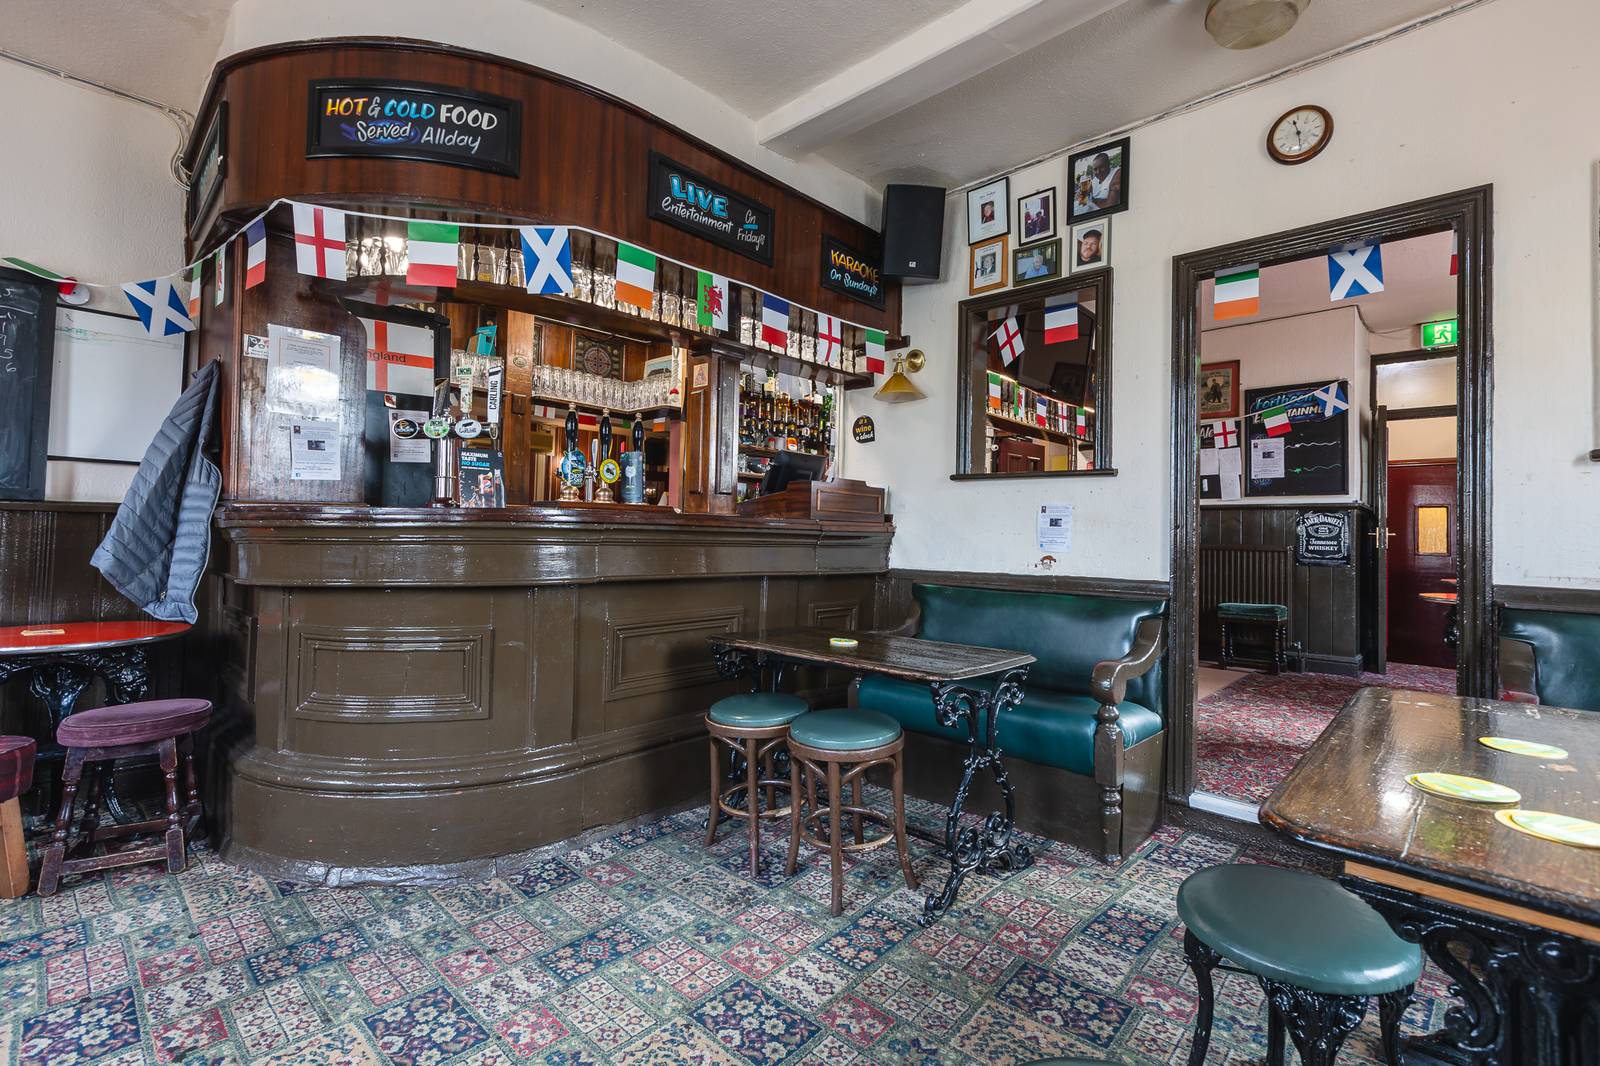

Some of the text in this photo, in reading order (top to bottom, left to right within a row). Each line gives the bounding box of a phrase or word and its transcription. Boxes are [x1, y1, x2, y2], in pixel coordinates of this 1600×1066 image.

[325, 96, 498, 130] HOT & COLD FOOD
[356, 120, 481, 155] Served Allday
[669, 174, 728, 219] LIVE
[745, 209, 756, 224] On
[736, 228, 766, 251] Fridays
[830, 249, 879, 284] KARAOKE
[830, 268, 878, 297] On Sundays
[366, 351, 406, 363] ngland
[489, 380, 498, 410] CARLING
[461, 451, 488, 459] MAXIMUM
[1304, 515, 1320, 527] JACK
